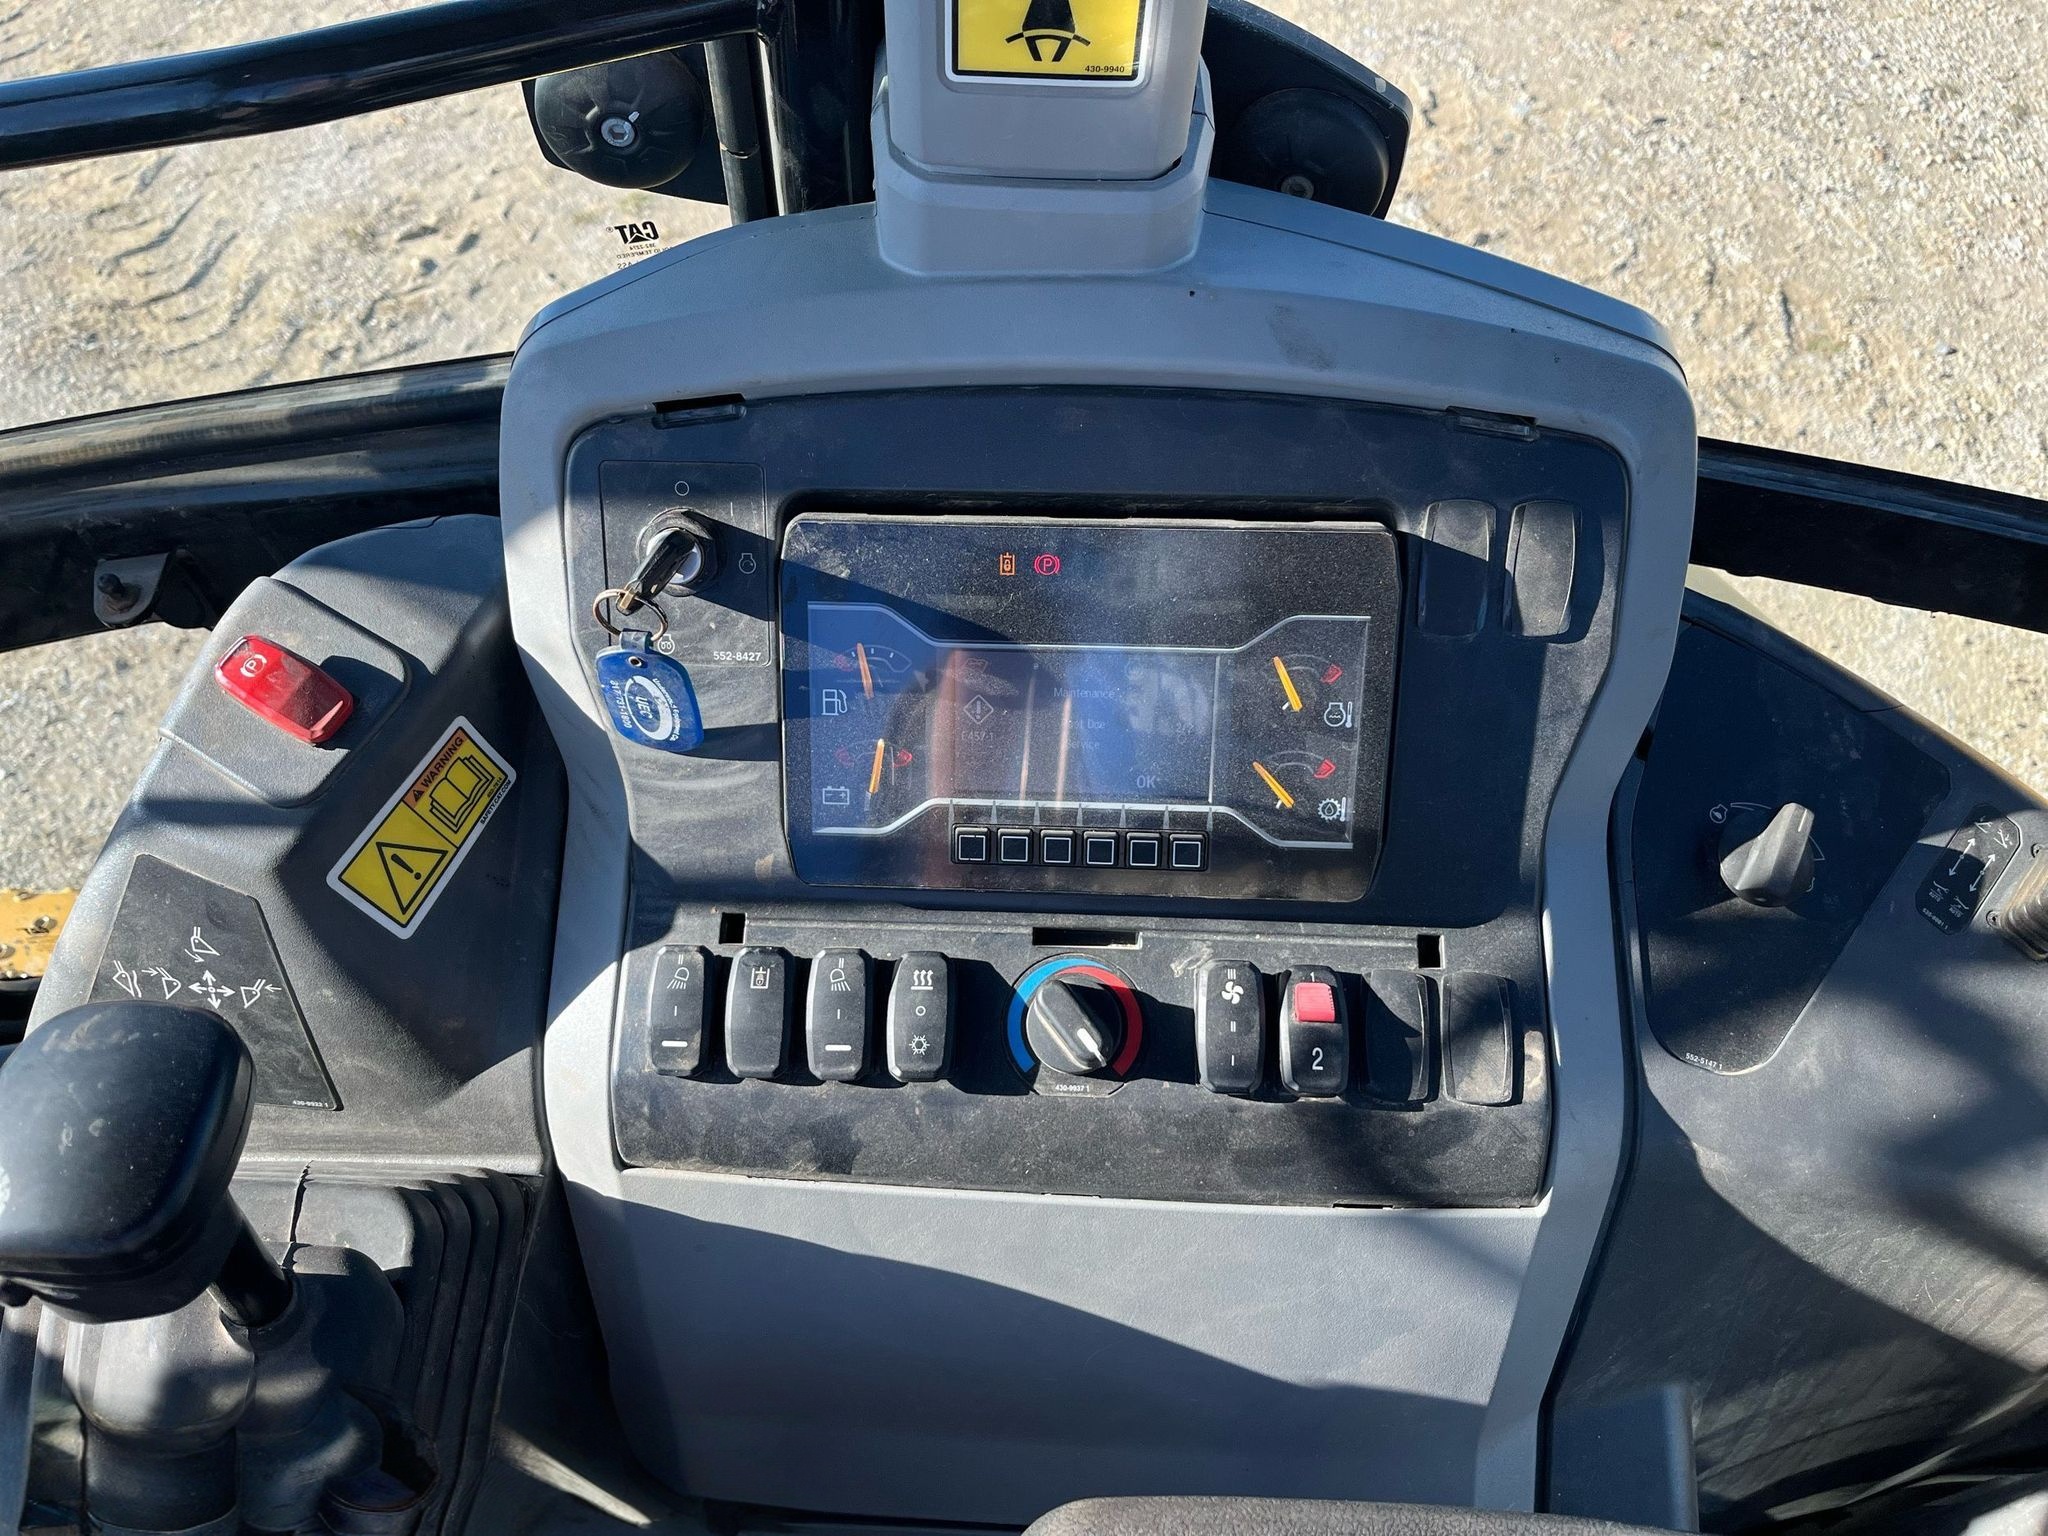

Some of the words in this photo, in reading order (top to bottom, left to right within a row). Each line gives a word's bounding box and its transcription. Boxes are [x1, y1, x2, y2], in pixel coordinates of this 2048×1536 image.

[1084, 65, 1125, 73] 430-9940
[713, 651, 762, 661] 552-8427
[1053, 687, 1115, 699] Maintenance
[635, 696, 653, 719] UEC
[421, 736, 464, 789] WARNING
[1136, 774, 1157, 789] OK
[480, 779, 512, 825] SAFETY.CAT.COM
[1311, 1047, 1324, 1071] 2
[1685, 1052, 1717, 1068] 552-5147
